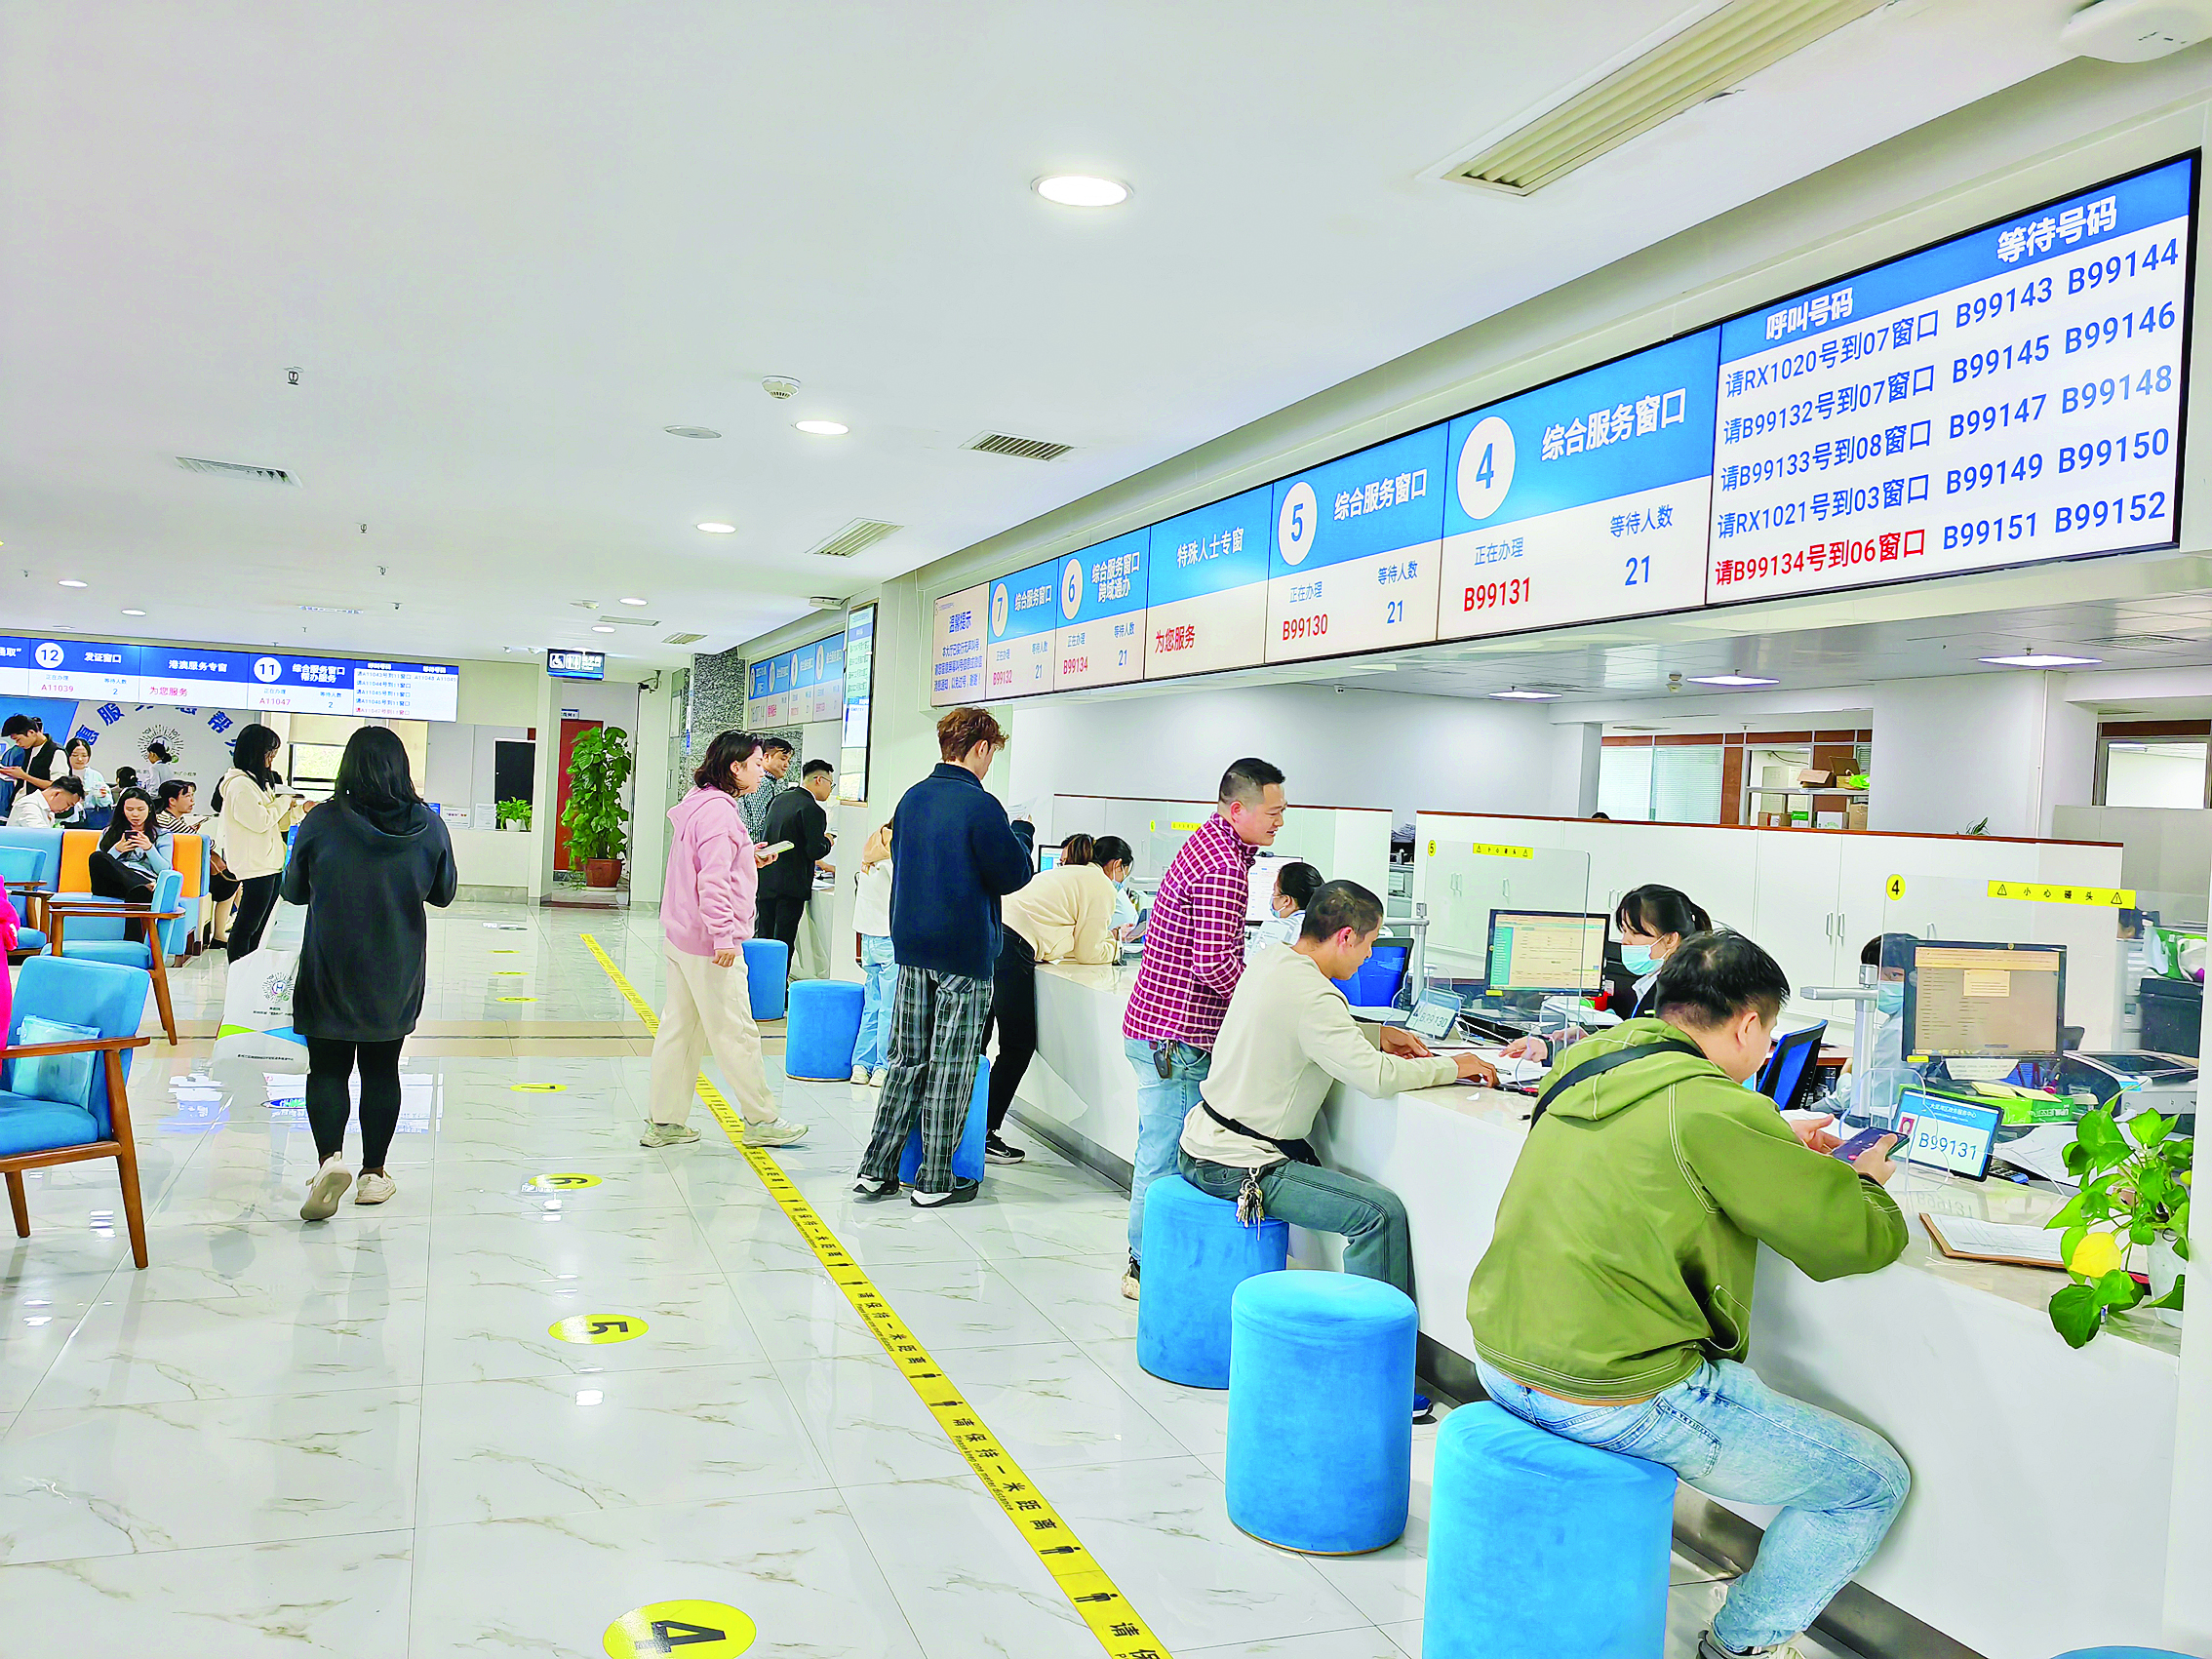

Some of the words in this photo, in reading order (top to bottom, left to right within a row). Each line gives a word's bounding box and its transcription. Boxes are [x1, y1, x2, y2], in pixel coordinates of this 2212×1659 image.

[1996, 195, 2117, 263] 等待号码
[1725, 309, 1939, 398] 请RX1020号到07窗口
[1955, 277, 2053, 329] B99143
[2068, 239, 2179, 295] B99144
[1765, 288, 1853, 341] 呼叫号码
[1723, 366, 1935, 446] 请B99132号到07窗口
[1953, 336, 2050, 383] B99145
[2065, 301, 2176, 354] B99146
[1476, 443, 1494, 490] 4
[1541, 388, 1685, 461] 综合服务窗口
[1721, 419, 1932, 492] 请B99133号到08窗口
[1950, 394, 2047, 439] B99147
[2061, 365, 2172, 415] B99148
[1718, 474, 1929, 539] 请RX1021号到03窗口
[1946, 454, 2043, 494] B99149
[2058, 428, 2169, 474] B99150
[1290, 504, 1304, 541] 5
[1333, 468, 1427, 522] 综合服务窗口
[1176, 528, 1244, 569] 特殊人士专窗
[1475, 537, 1523, 566] 正在办理
[1610, 504, 1674, 538] 等待人数
[1715, 529, 1925, 587] 请B99134号到06窗口
[1943, 513, 2037, 550] B99151
[2055, 492, 2166, 533] B99152
[1068, 573, 1076, 601] 6
[1091, 551, 1140, 584] 综合服务窗口
[1289, 581, 1323, 604] 正在办理
[1377, 561, 1417, 585] 等待人数
[1464, 577, 1530, 612] B99131
[1625, 556, 1651, 585] 21
[997, 598, 1004, 622] 7
[1014, 585, 1052, 612] 综合服务窗口
[1283, 613, 1327, 641] B99130
[1387, 600, 1403, 624] 21
[40, 649, 59, 661] 12
[84, 652, 122, 664] 发证窗口
[1154, 624, 1196, 654] 为您服务
[168, 659, 228, 673] 港澳服务专窗
[258, 663, 275, 676] 11
[292, 662, 346, 676] 综合服务窗口
[1035, 664, 1043, 680] 21
[1063, 656, 1088, 675] B99134
[1119, 650, 1127, 667] 21
[149, 686, 188, 697] 为您服务
[258, 697, 292, 706] A11047
[1430, 843, 1435, 854] 5
[1891, 880, 1900, 895] 4
[1918, 1132, 1977, 1160] B99131
[589, 1321, 629, 1335] 5
[953, 1417, 1057, 1530] 请保持一米距离
[634, 1620, 727, 1654] 4
